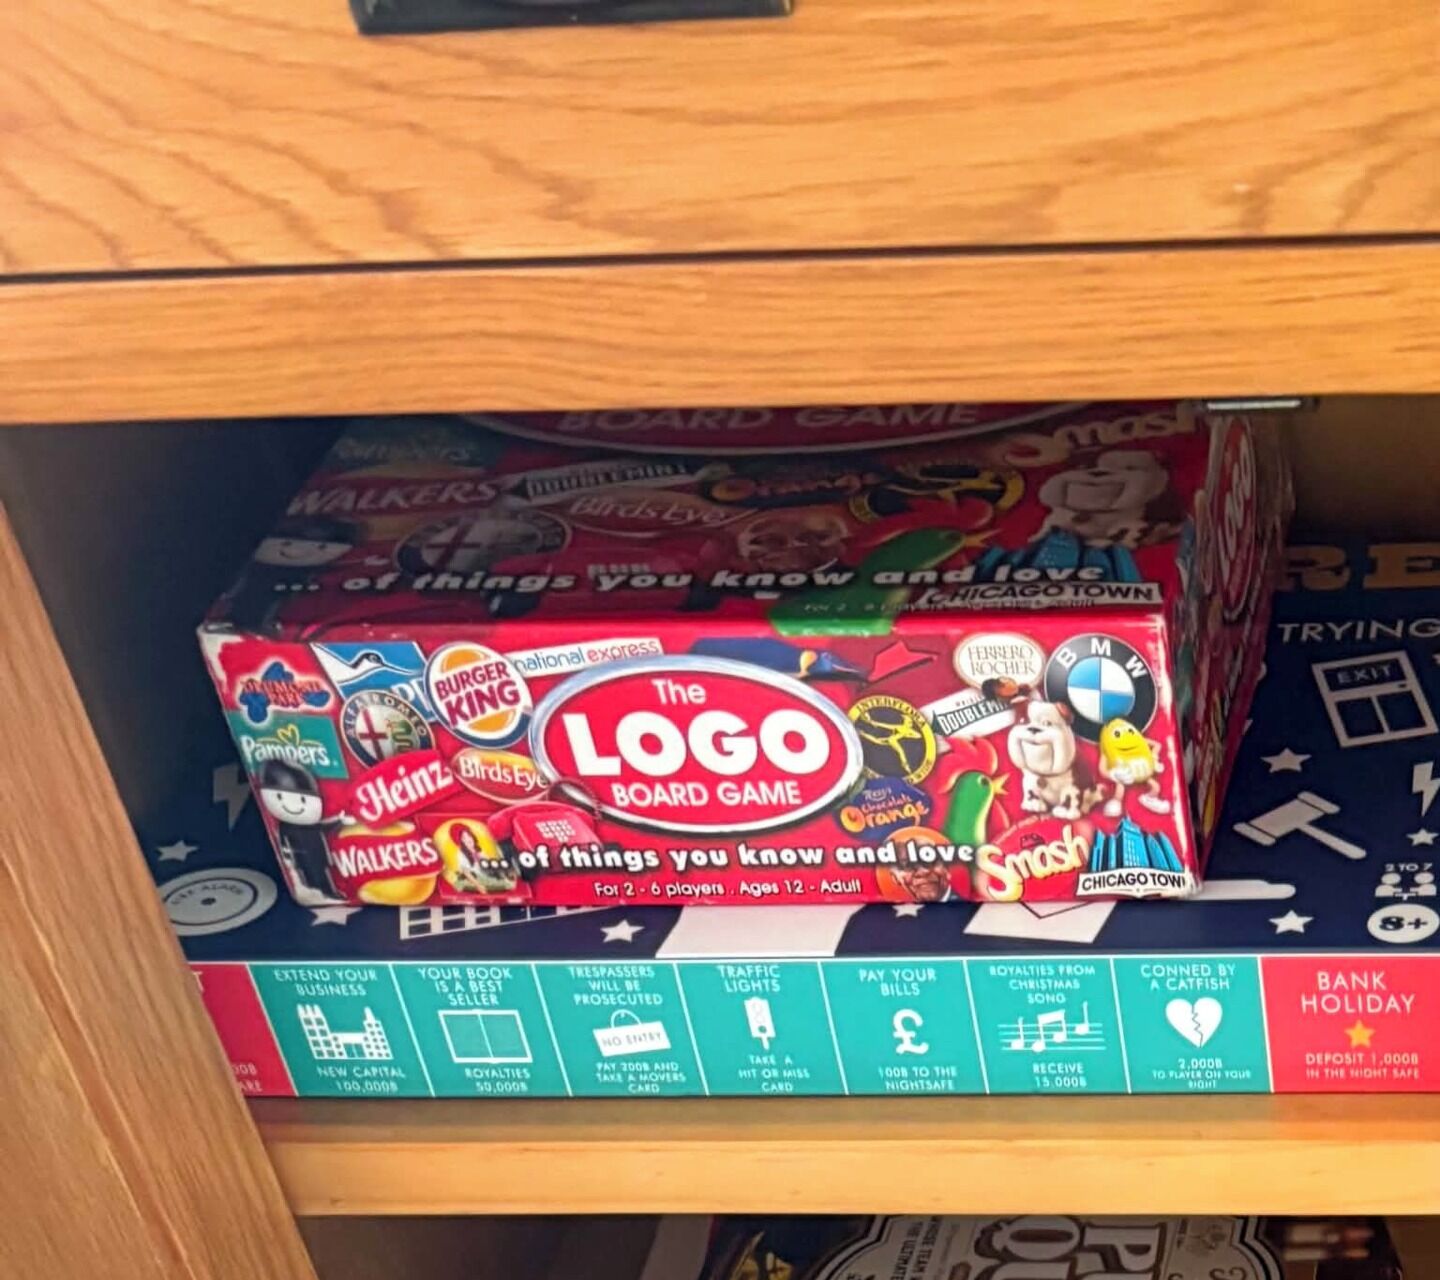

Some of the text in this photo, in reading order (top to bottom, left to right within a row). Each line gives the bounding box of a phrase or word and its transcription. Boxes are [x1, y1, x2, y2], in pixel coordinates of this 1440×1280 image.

[794, 404, 981, 428] GAME
[287, 479, 500, 517] WALKERS
[345, 563, 1105, 597] of things you know and love
[1068, 584, 1155, 602] TOWN
[514, 637, 660, 674] national express
[966, 643, 1034, 661] FERRERO
[970, 659, 1036, 675] ROCHER
[1336, 663, 1394, 685] EXIT
[434, 661, 512, 698] BURGER
[652, 678, 707, 705] The
[441, 681, 521, 726] KING
[561, 709, 830, 777] LOGO
[355, 760, 453, 822] Heinz
[611, 780, 803, 807] BOARD GAME
[333, 836, 440, 878] WALKERS
[519, 841, 974, 872] of things you know and love
[976, 824, 1090, 902] Smash
[594, 880, 619, 896] For
[624, 880, 635, 896] 2
[651, 880, 660, 896] 6
[666, 880, 726, 899] players
[739, 880, 780, 897] Ages
[784, 880, 804, 895] 12
[1082, 872, 1149, 891] CHICAGO
[274, 968, 377, 981] EXTEND YOUR
[418, 967, 512, 979] YOUR BOOK
[568, 966, 655, 979] TRESPASSERS
[717, 966, 780, 979] TRAFFIC
[859, 968, 936, 982] PAY YOUR
[1141, 964, 1236, 978] CONNED BY
[435, 980, 502, 992] IS A BEST
[589, 980, 641, 992] WILL BE
[725, 980, 781, 993] LIGHTS
[880, 983, 920, 996] BILLS
[1166, 978, 1230, 990] CATFISH
[1316, 971, 1386, 990] BANK
[296, 984, 366, 997] BUSINESS
[1028, 993, 1066, 1004] SONG
[449, 994, 498, 1006] SELLER
[574, 994, 663, 1006] PROSECUTED
[1301, 994, 1415, 1014] HOLIDAY
[1033, 1062, 1084, 1075] RECEIVE
[1305, 1053, 1363, 1066] DEPOSIT
[1324, 1068, 1419, 1080] THE NIGHT SAFE
[761, 1082, 793, 1093] CARD
[914, 1248, 933, 1273] TEAM
